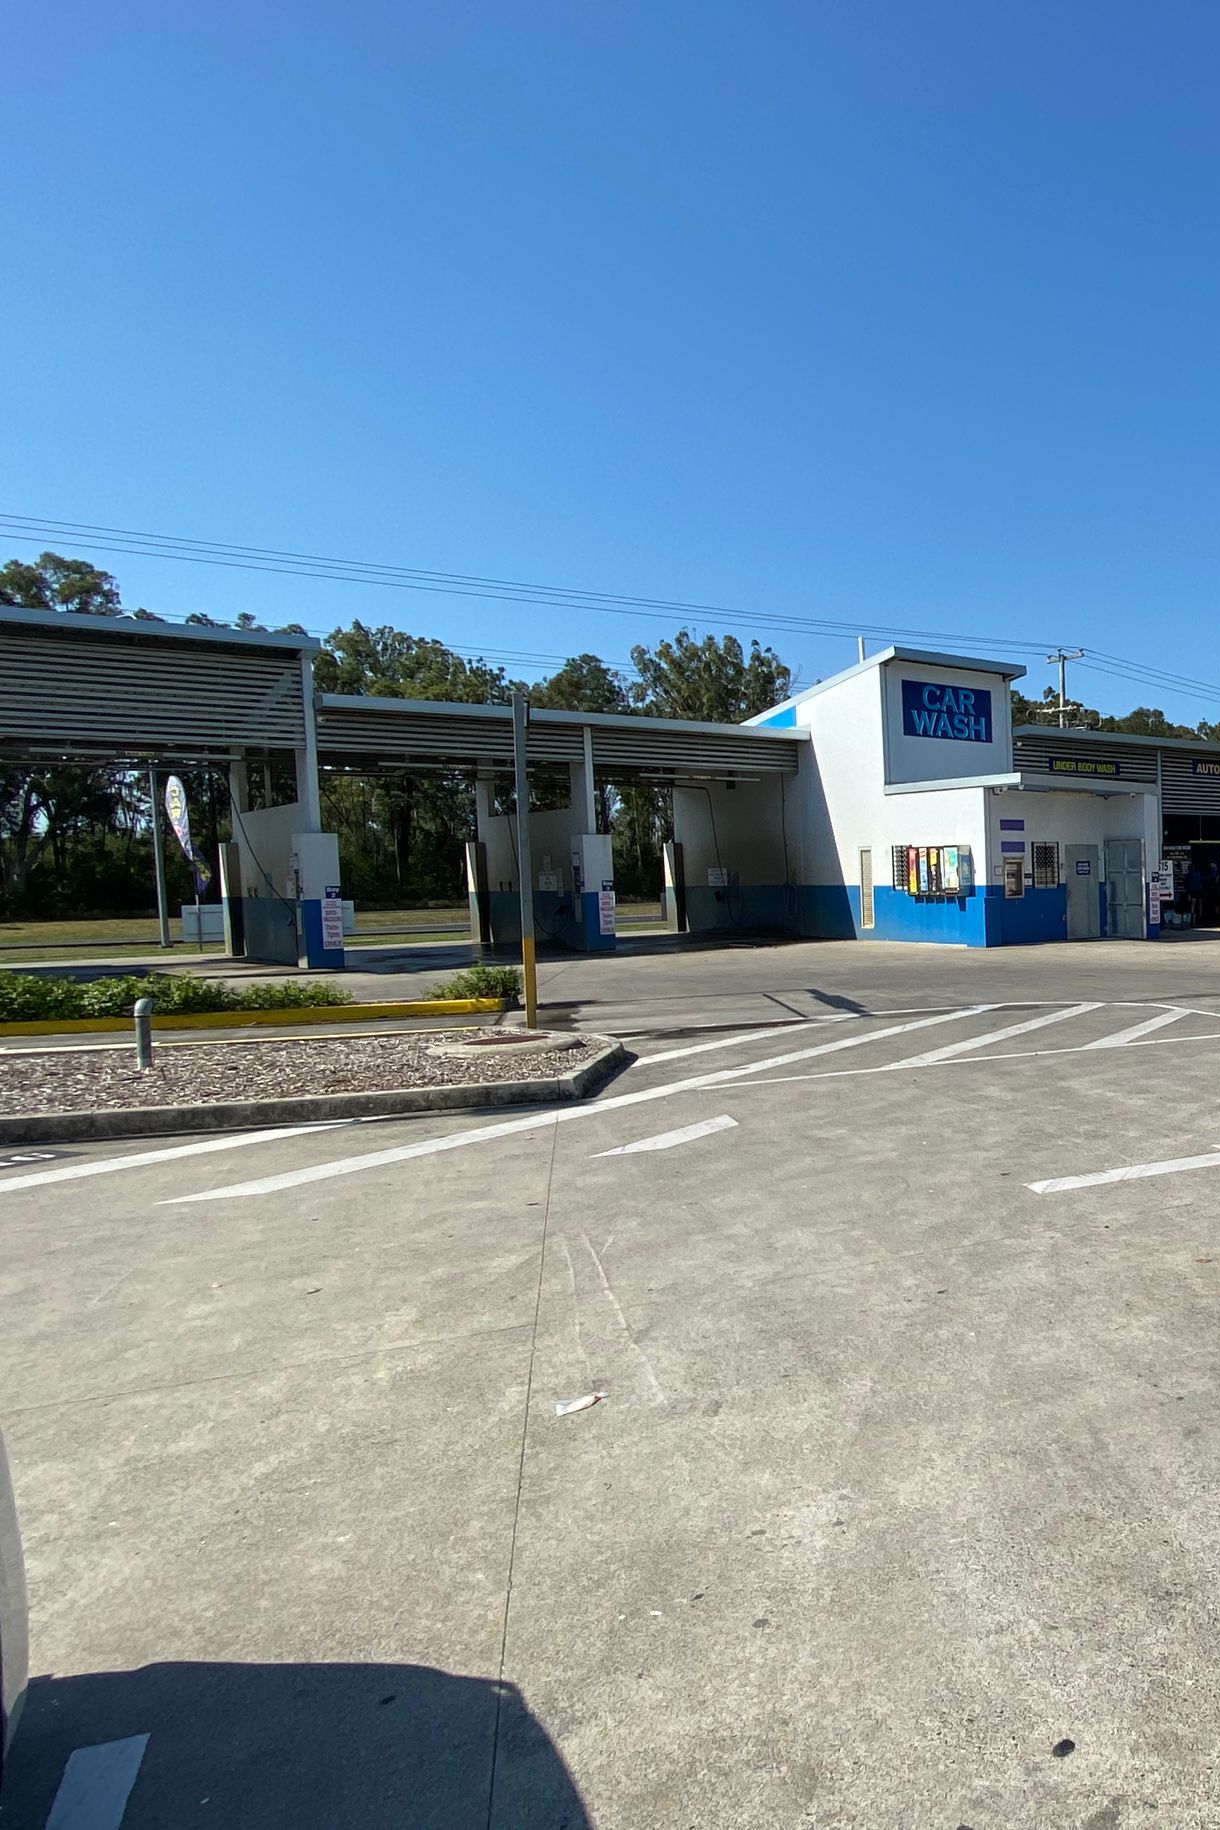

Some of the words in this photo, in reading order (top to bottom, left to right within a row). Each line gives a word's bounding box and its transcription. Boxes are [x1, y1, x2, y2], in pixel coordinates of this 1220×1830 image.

[922, 685, 976, 715] CAR
[911, 709, 986, 740] WASH
[1053, 760, 1077, 771] UNDER
[1077, 762, 1095, 772] BODY
[1096, 763, 1116, 774] WASH
